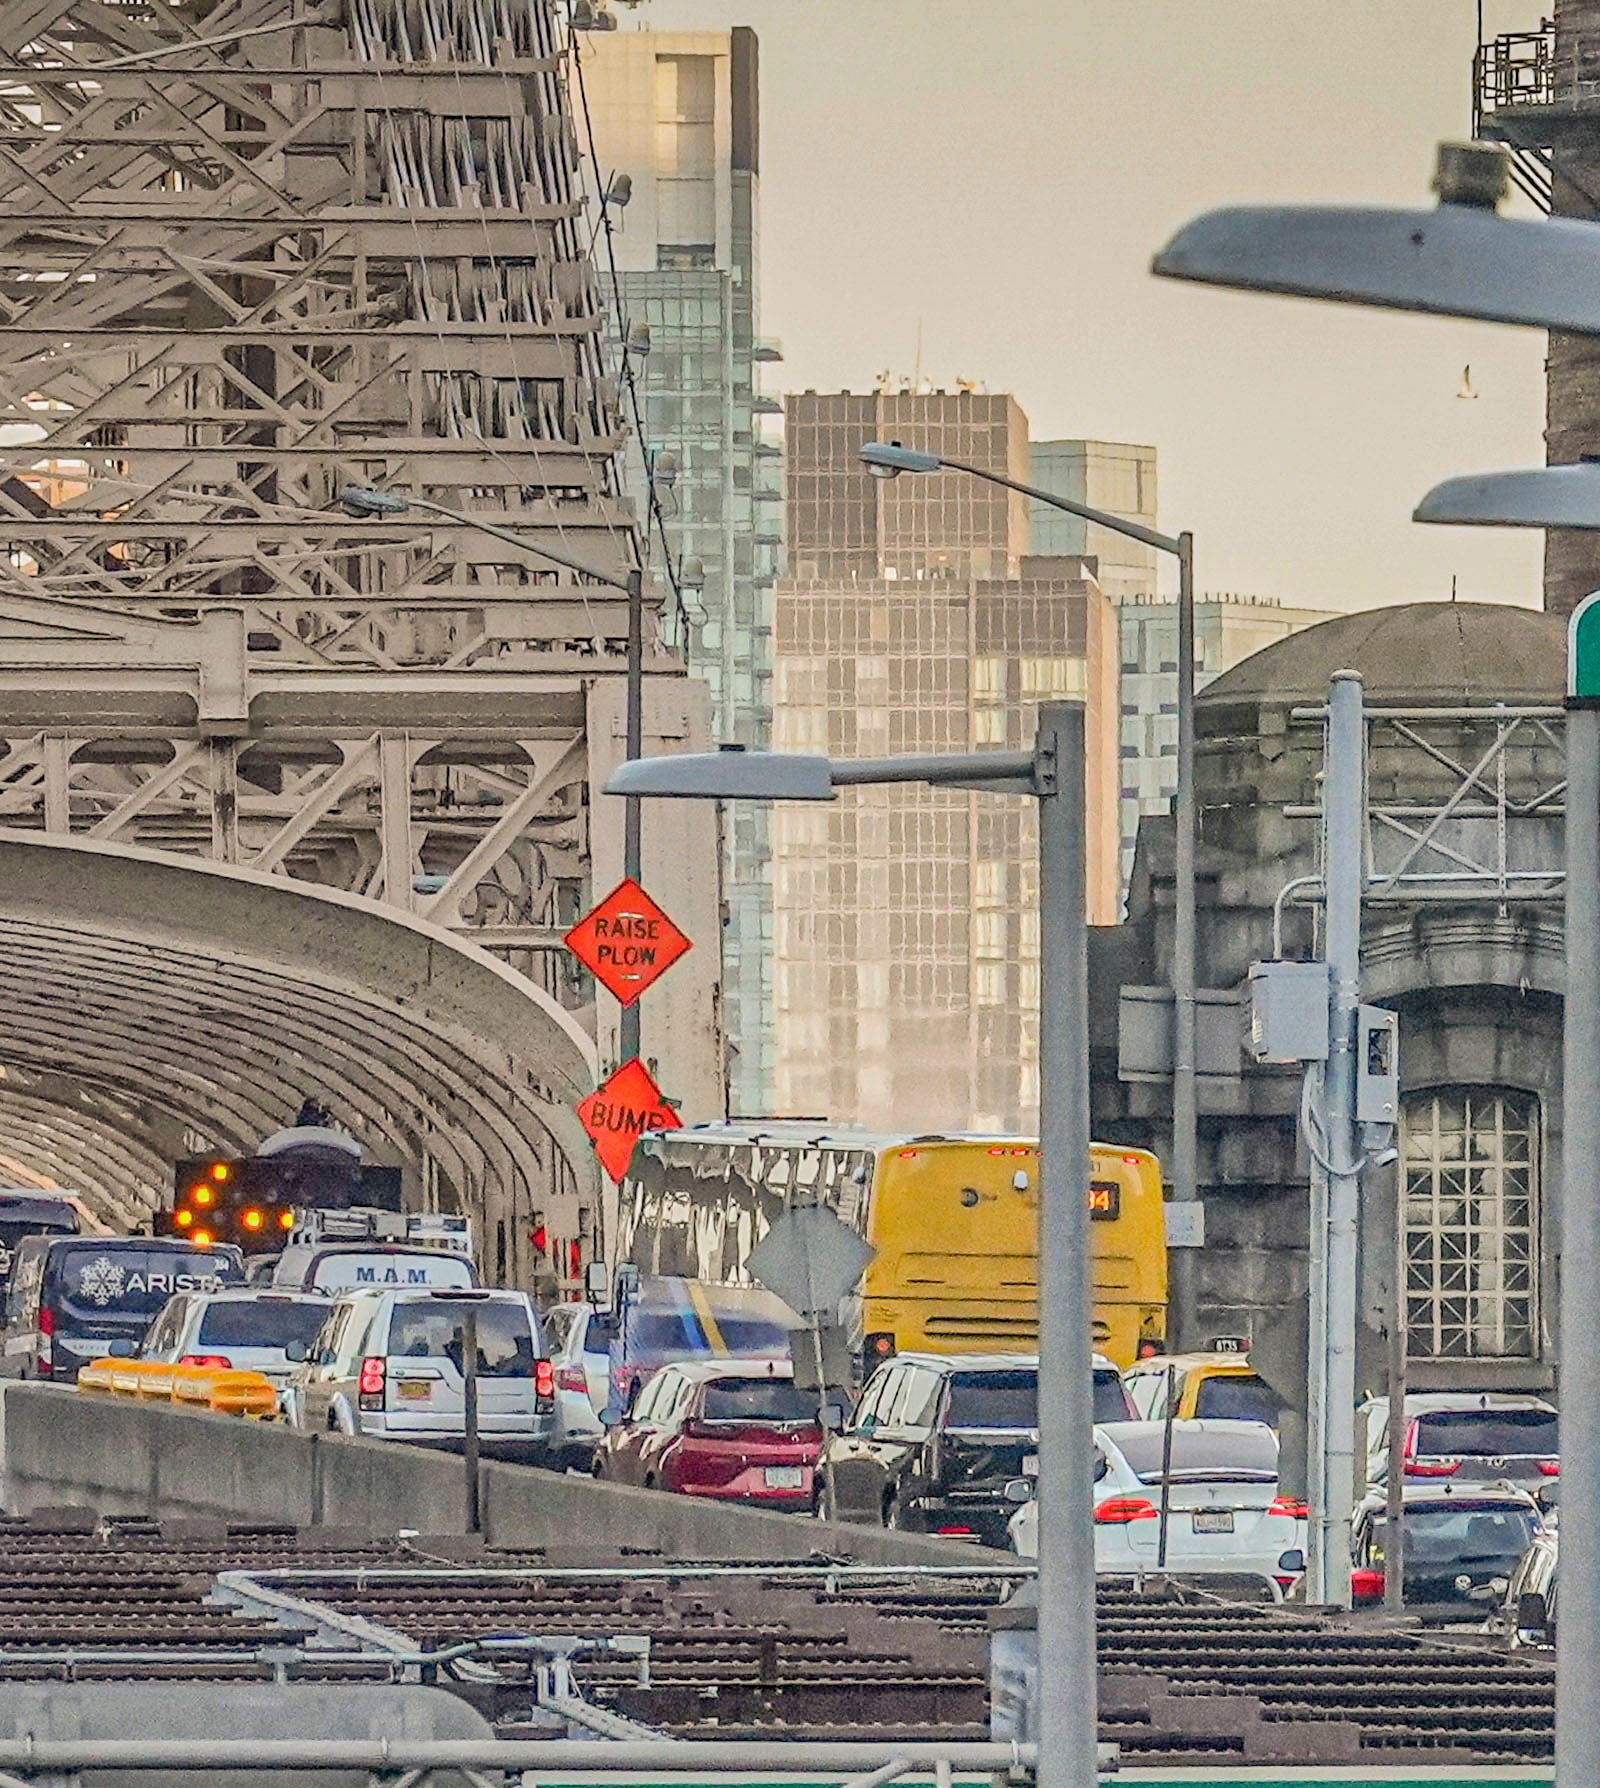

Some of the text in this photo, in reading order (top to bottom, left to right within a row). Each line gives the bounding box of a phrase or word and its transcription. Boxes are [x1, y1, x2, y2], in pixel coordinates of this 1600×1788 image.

[594, 918, 660, 942] RAISE
[597, 945, 656, 966] PLOW
[590, 1102, 666, 1134] BUMP
[356, 1267, 432, 1285] M.A.M.
